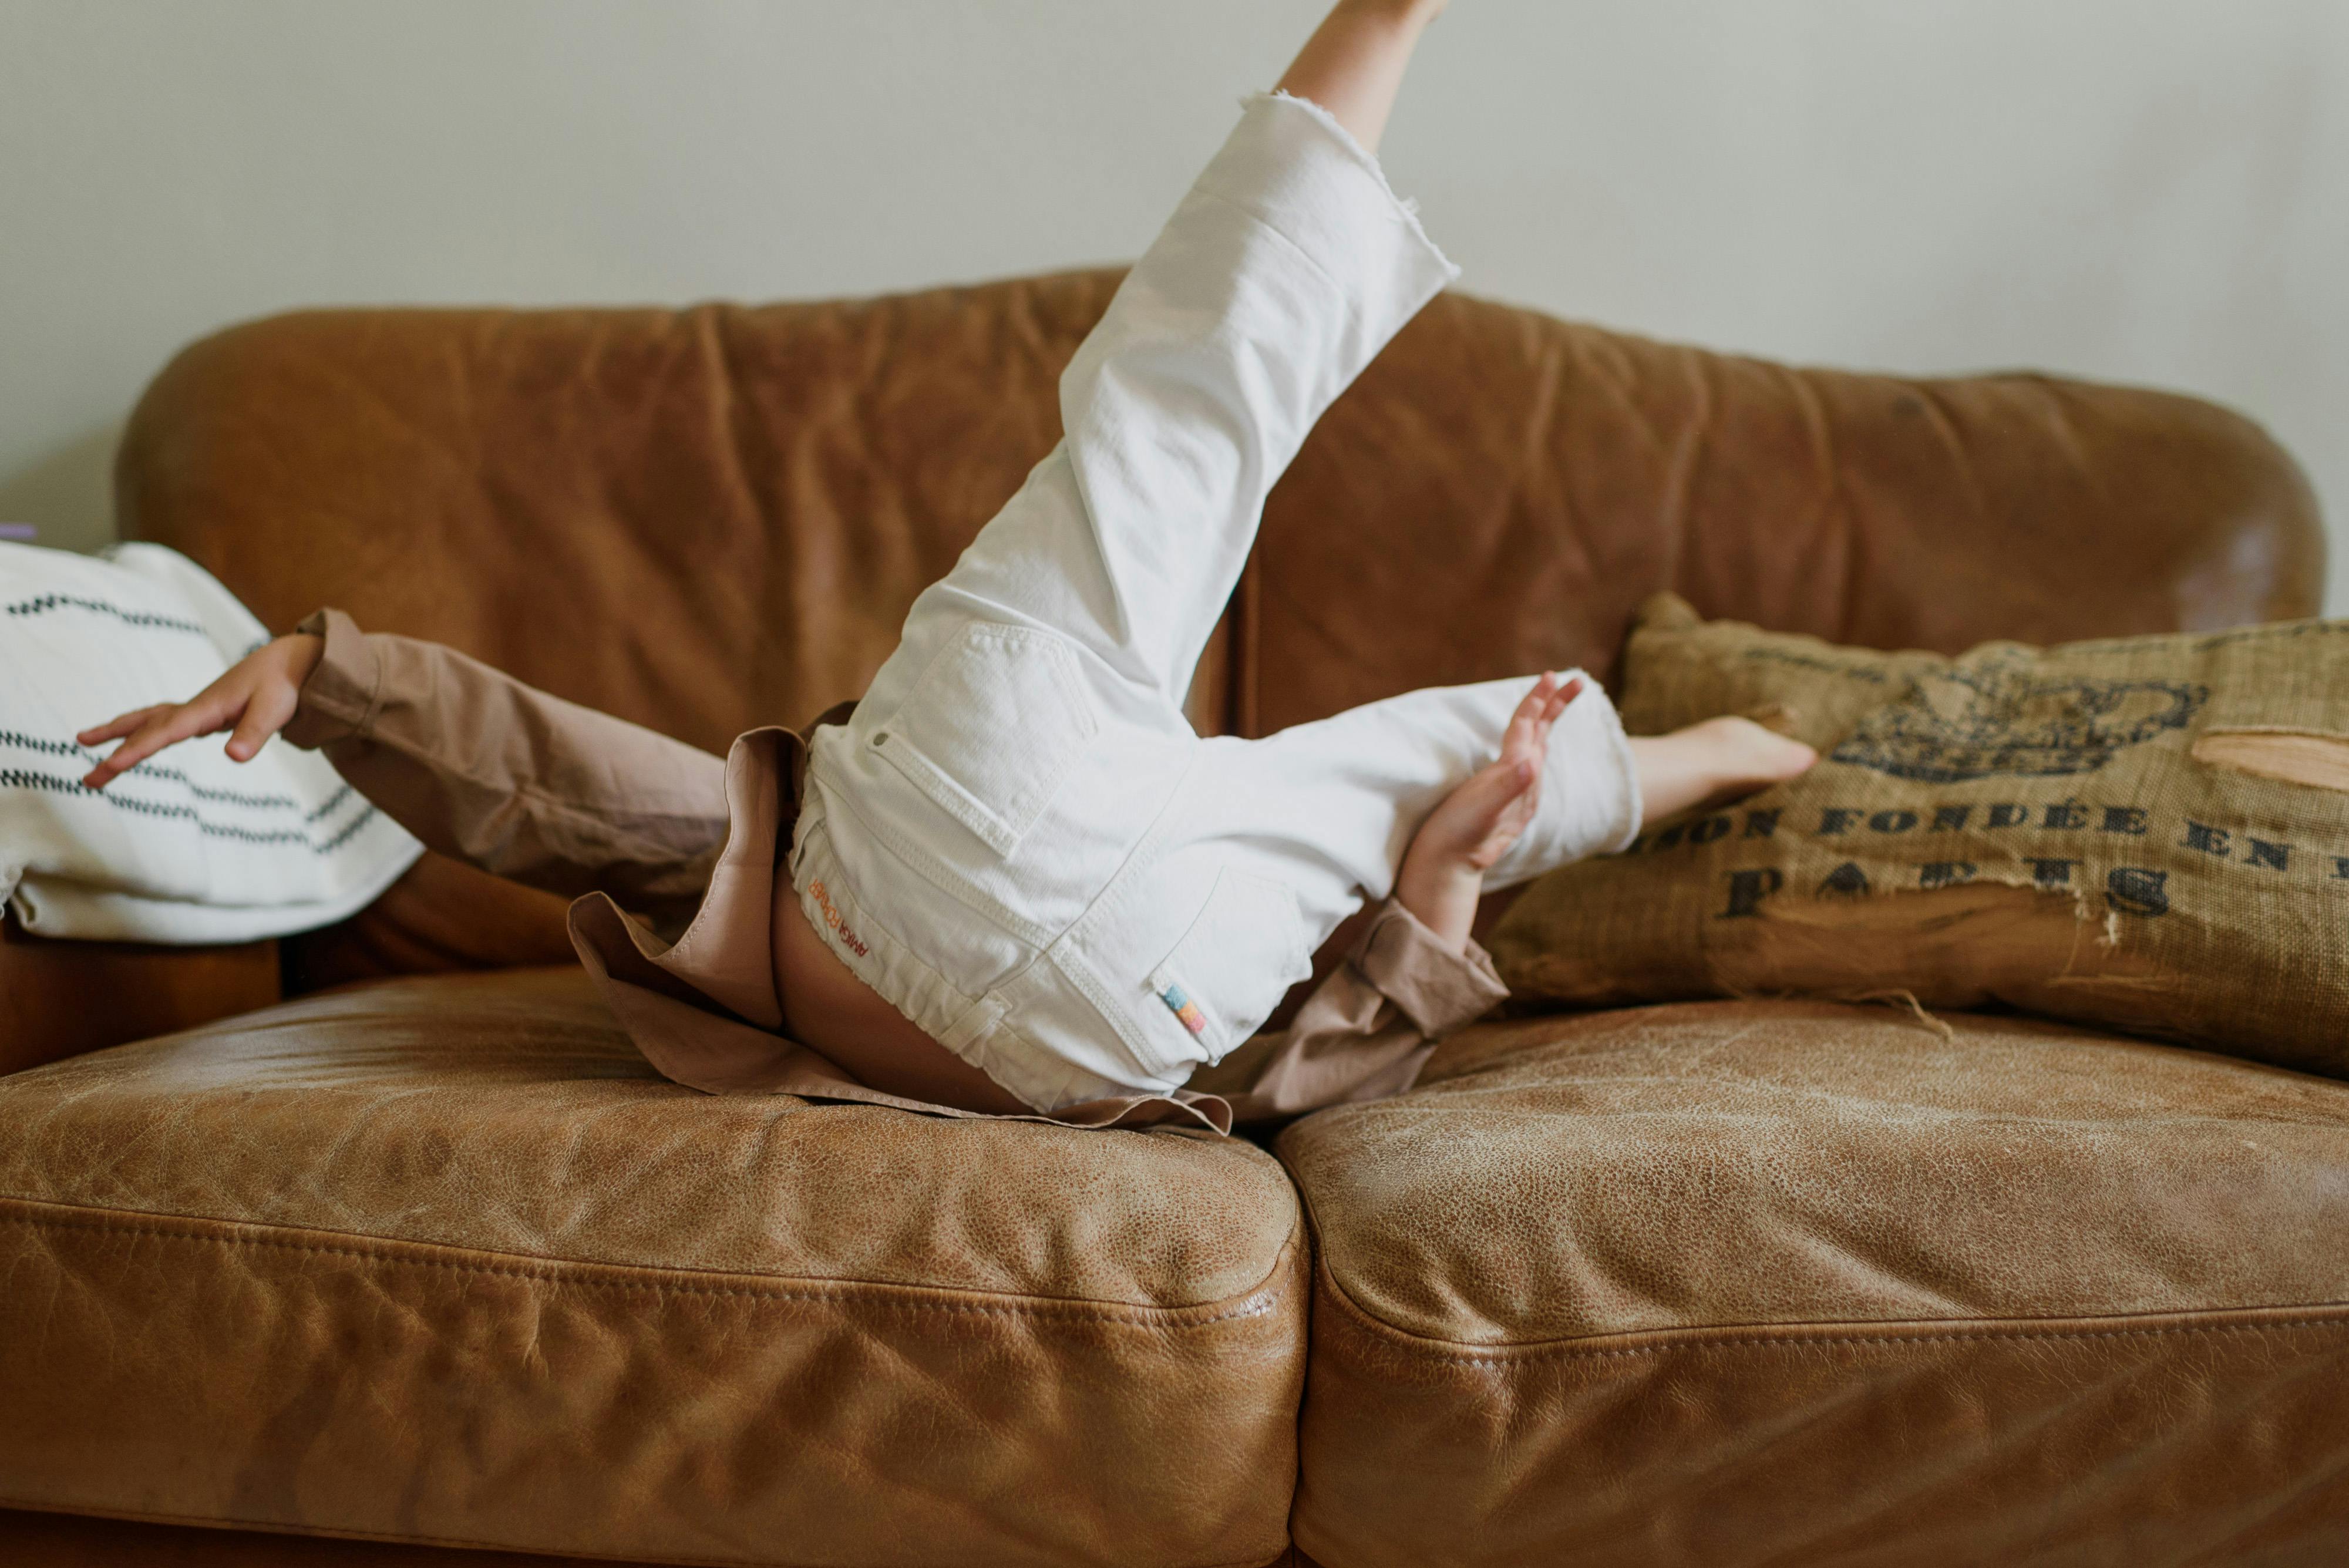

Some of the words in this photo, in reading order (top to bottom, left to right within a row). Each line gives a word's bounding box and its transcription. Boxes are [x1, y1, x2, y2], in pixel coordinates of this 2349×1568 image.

[1816, 798, 2148, 835] FONDÉE
[2178, 818, 2294, 873] EN
[839, 917, 869, 958] AMIGA
